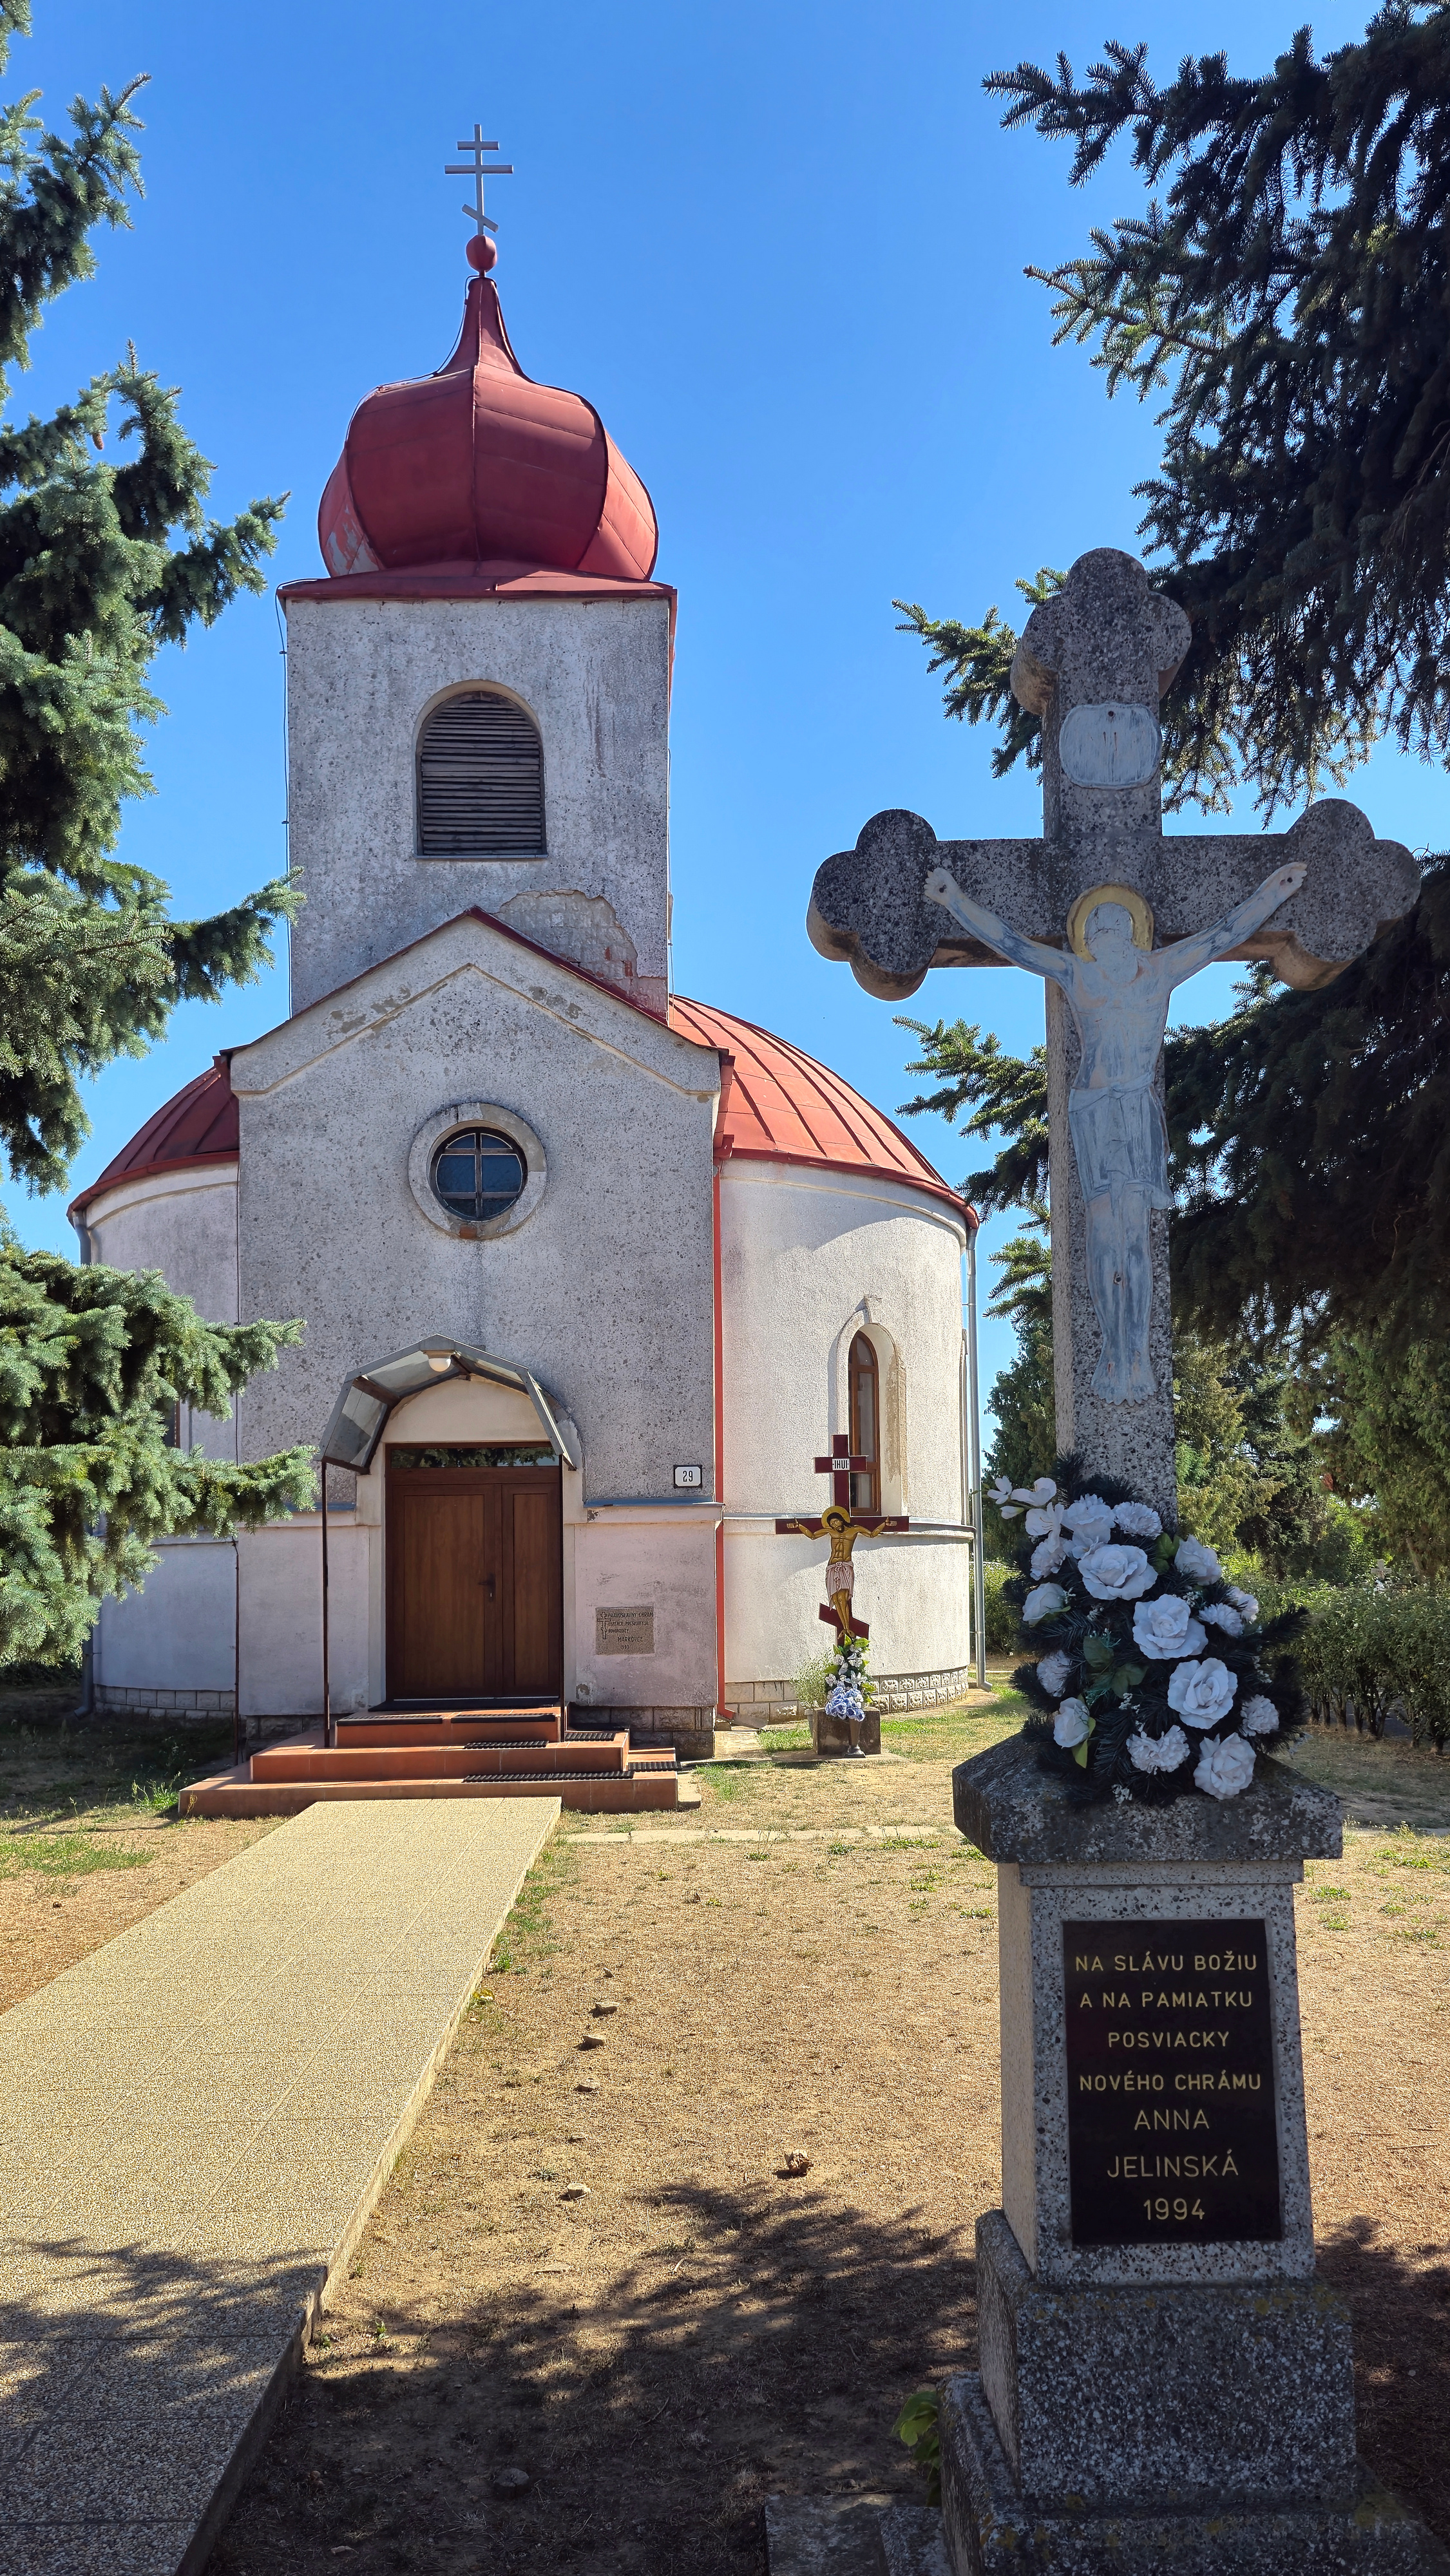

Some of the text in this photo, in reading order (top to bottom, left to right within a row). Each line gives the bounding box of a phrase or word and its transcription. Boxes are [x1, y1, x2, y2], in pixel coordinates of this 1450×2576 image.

[683, 1470, 693, 1482] 29
[1076, 1950, 1257, 1971] NA SLÁVU BOŽIU
[1080, 1991, 1252, 2008] A NA PAMIATKU
[1108, 2031, 1229, 2048] POSVIACKY
[1080, 2069, 1261, 2091] NOVÉHO CHRÁMU
[1134, 2108, 1210, 2130] ANNA
[1107, 2148, 1239, 2178] JELINSKÁ
[1143, 2198, 1205, 2221] 1994
